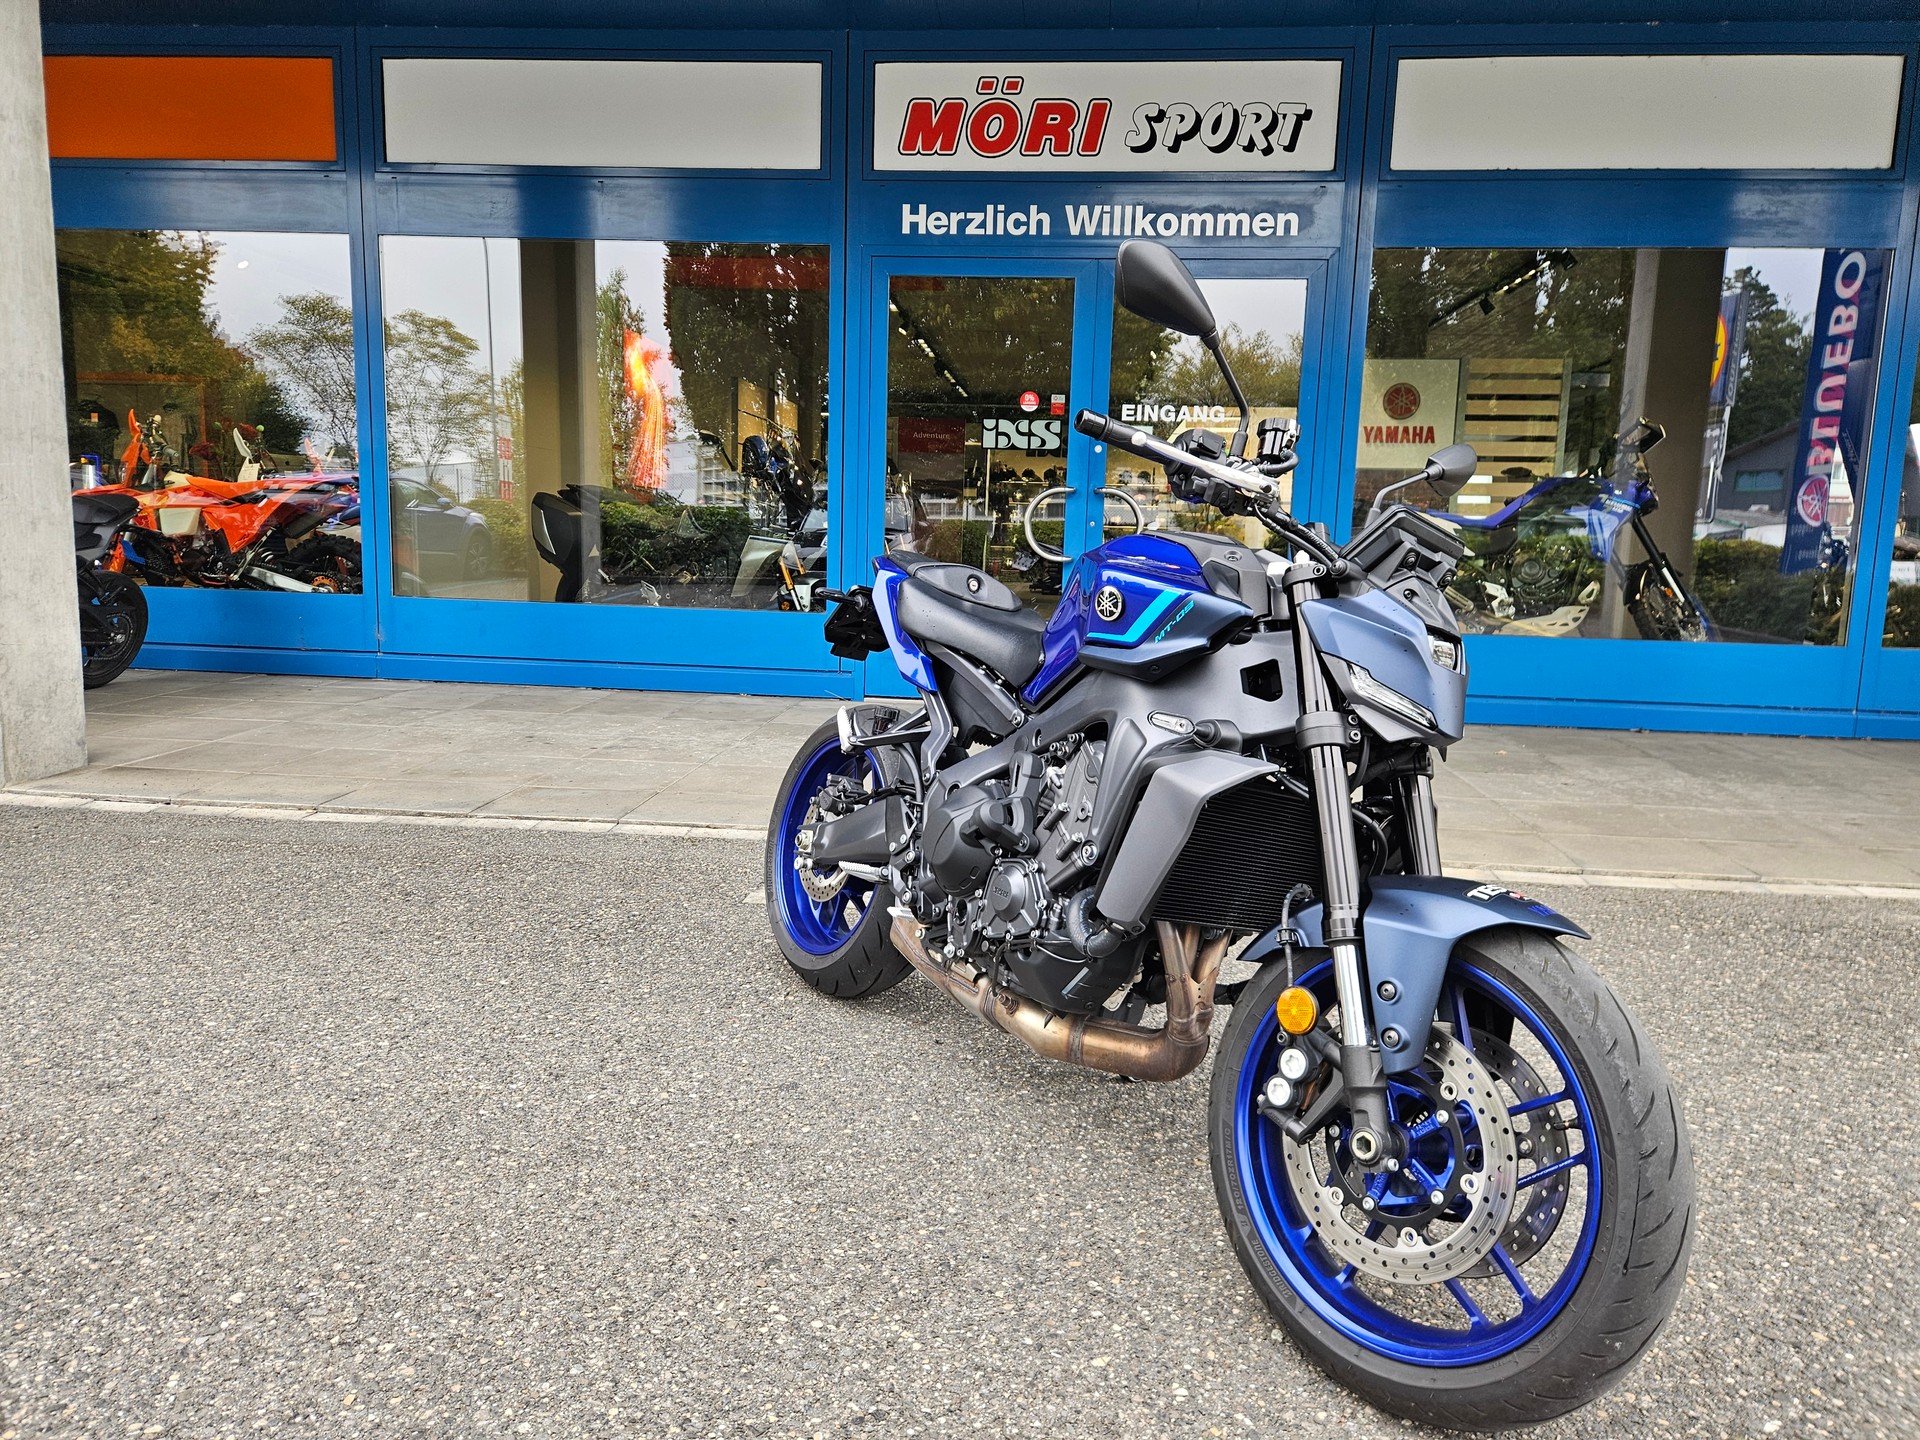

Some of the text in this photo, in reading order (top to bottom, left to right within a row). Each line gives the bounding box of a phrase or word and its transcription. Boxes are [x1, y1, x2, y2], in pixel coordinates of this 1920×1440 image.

[897, 75, 1313, 158] MÖRI SPORT
[901, 203, 1300, 238] Herzlich Willkommen
[1121, 403, 1225, 423] EINGANG
[912, 431, 951, 440] Adventure
[1363, 426, 1435, 444] YAMAHA
[1154, 600, 1195, 644] MT-09
[1250, 1238, 1292, 1299] BRIDGESTONE
